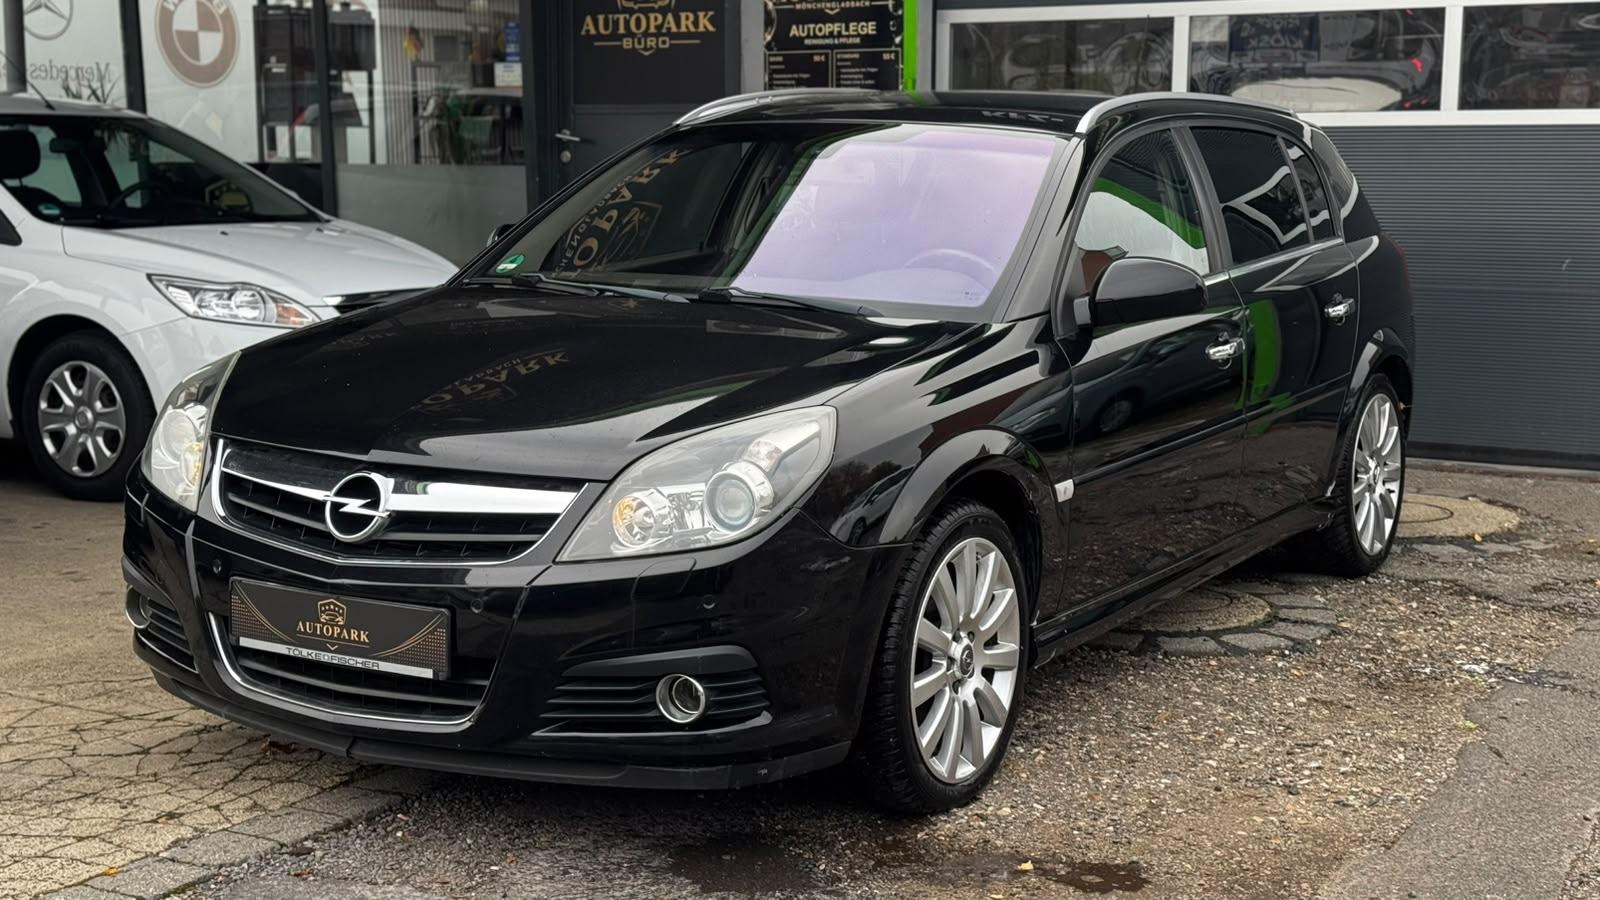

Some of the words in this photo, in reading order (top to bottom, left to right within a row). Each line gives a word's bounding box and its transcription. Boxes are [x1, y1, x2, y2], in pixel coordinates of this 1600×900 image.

[795, 1, 870, 10] MÖNCHENGLADBACH
[581, 10, 716, 35] AUTOPARK
[789, 21, 877, 38] AUTOPFLEGE
[622, 35, 670, 49] BÜRO
[296, 620, 370, 644] AUTOPARK
